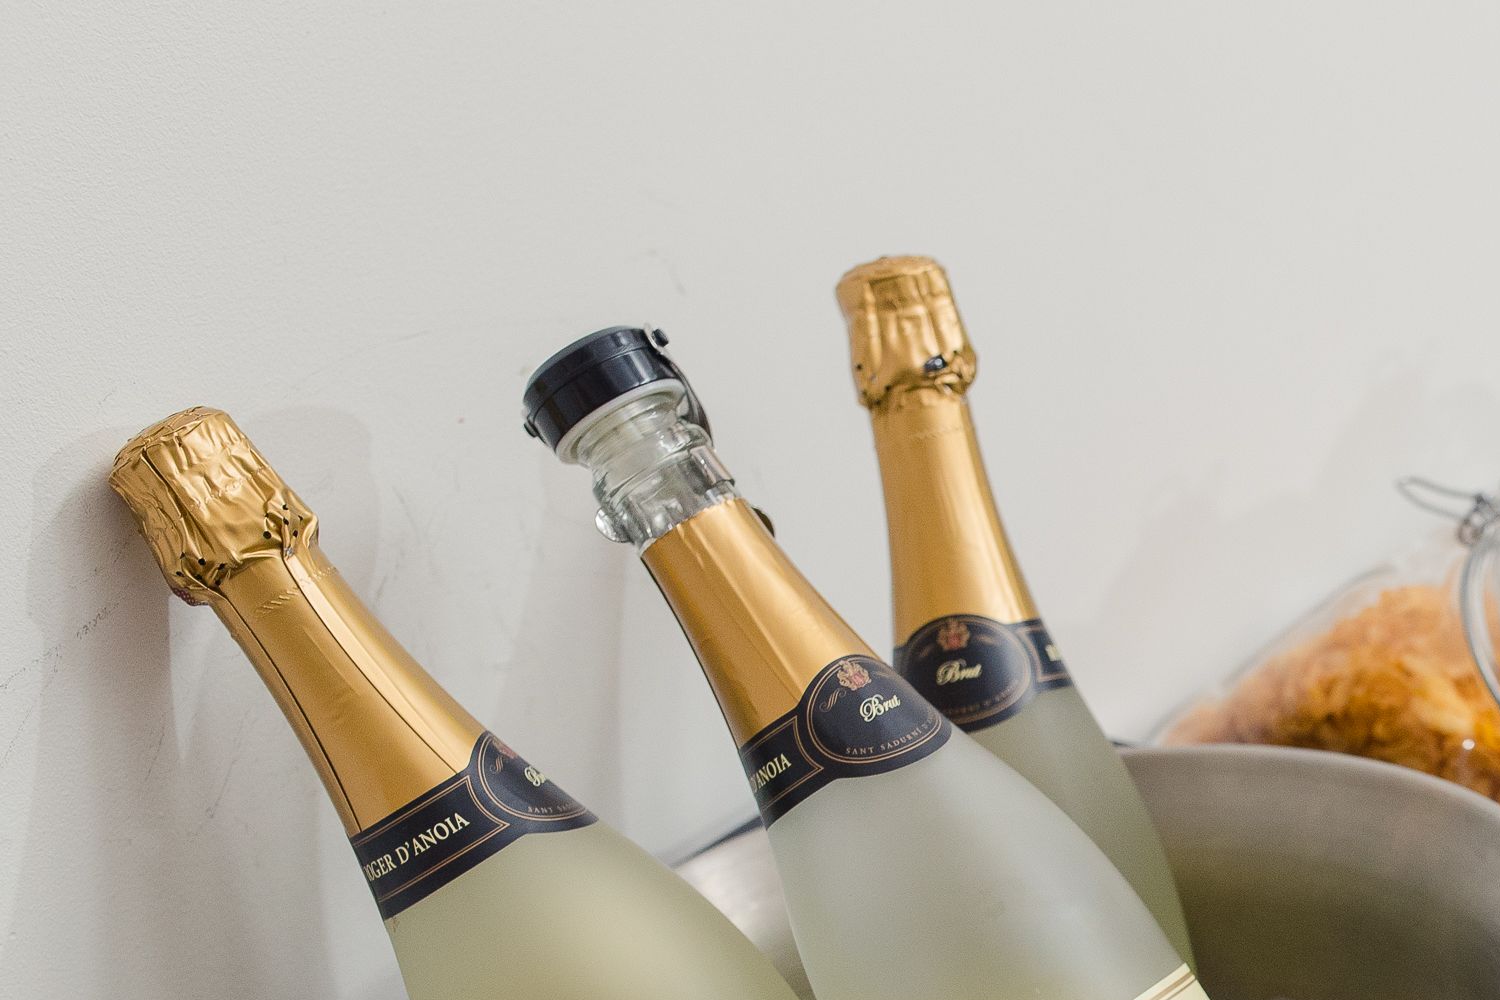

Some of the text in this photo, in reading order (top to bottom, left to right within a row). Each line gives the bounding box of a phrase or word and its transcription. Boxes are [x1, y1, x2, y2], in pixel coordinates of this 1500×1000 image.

[936, 658, 982, 686] Brut
[859, 694, 901, 722] Brut
[845, 726, 923, 755] SANT SADURNI
[395, 812, 471, 864] D'ANOIA
